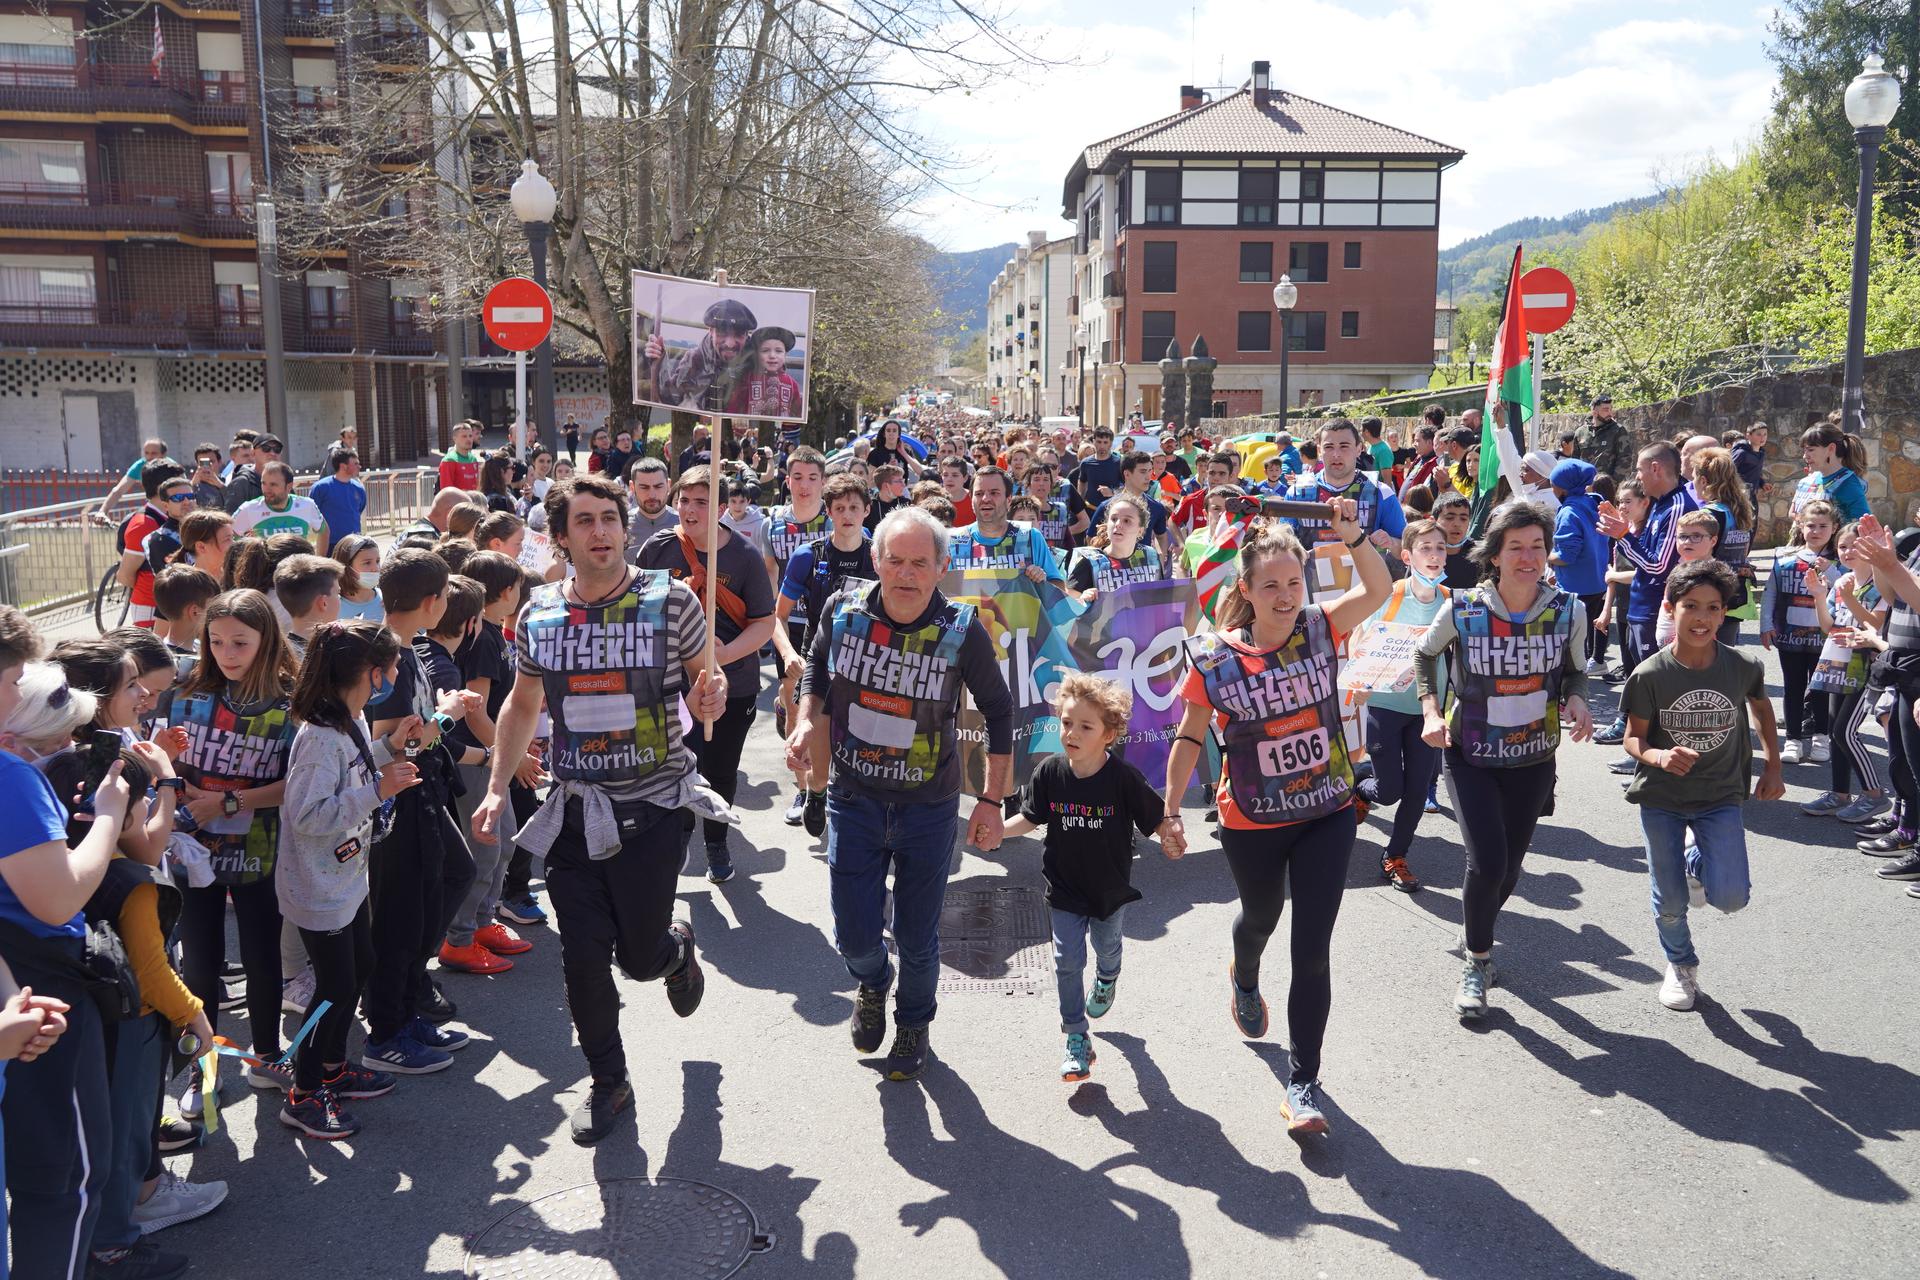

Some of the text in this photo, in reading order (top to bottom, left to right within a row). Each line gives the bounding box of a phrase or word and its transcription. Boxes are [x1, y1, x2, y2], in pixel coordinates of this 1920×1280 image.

[1776, 632, 1825, 646] 22.korrik
[572, 678, 610, 689] euskaltel
[1812, 671, 1857, 688] orrika
[1675, 692, 1728, 710] STREET SPORTS
[581, 734, 608, 752] aek
[1673, 732, 1726, 750] NEW YORK CITY
[858, 747, 883, 763] aek
[1268, 734, 1324, 774] 1506
[1286, 772, 1312, 794] aek
[1050, 800, 1114, 817] euskeraz bizi
[1061, 816, 1103, 831] gura dot
